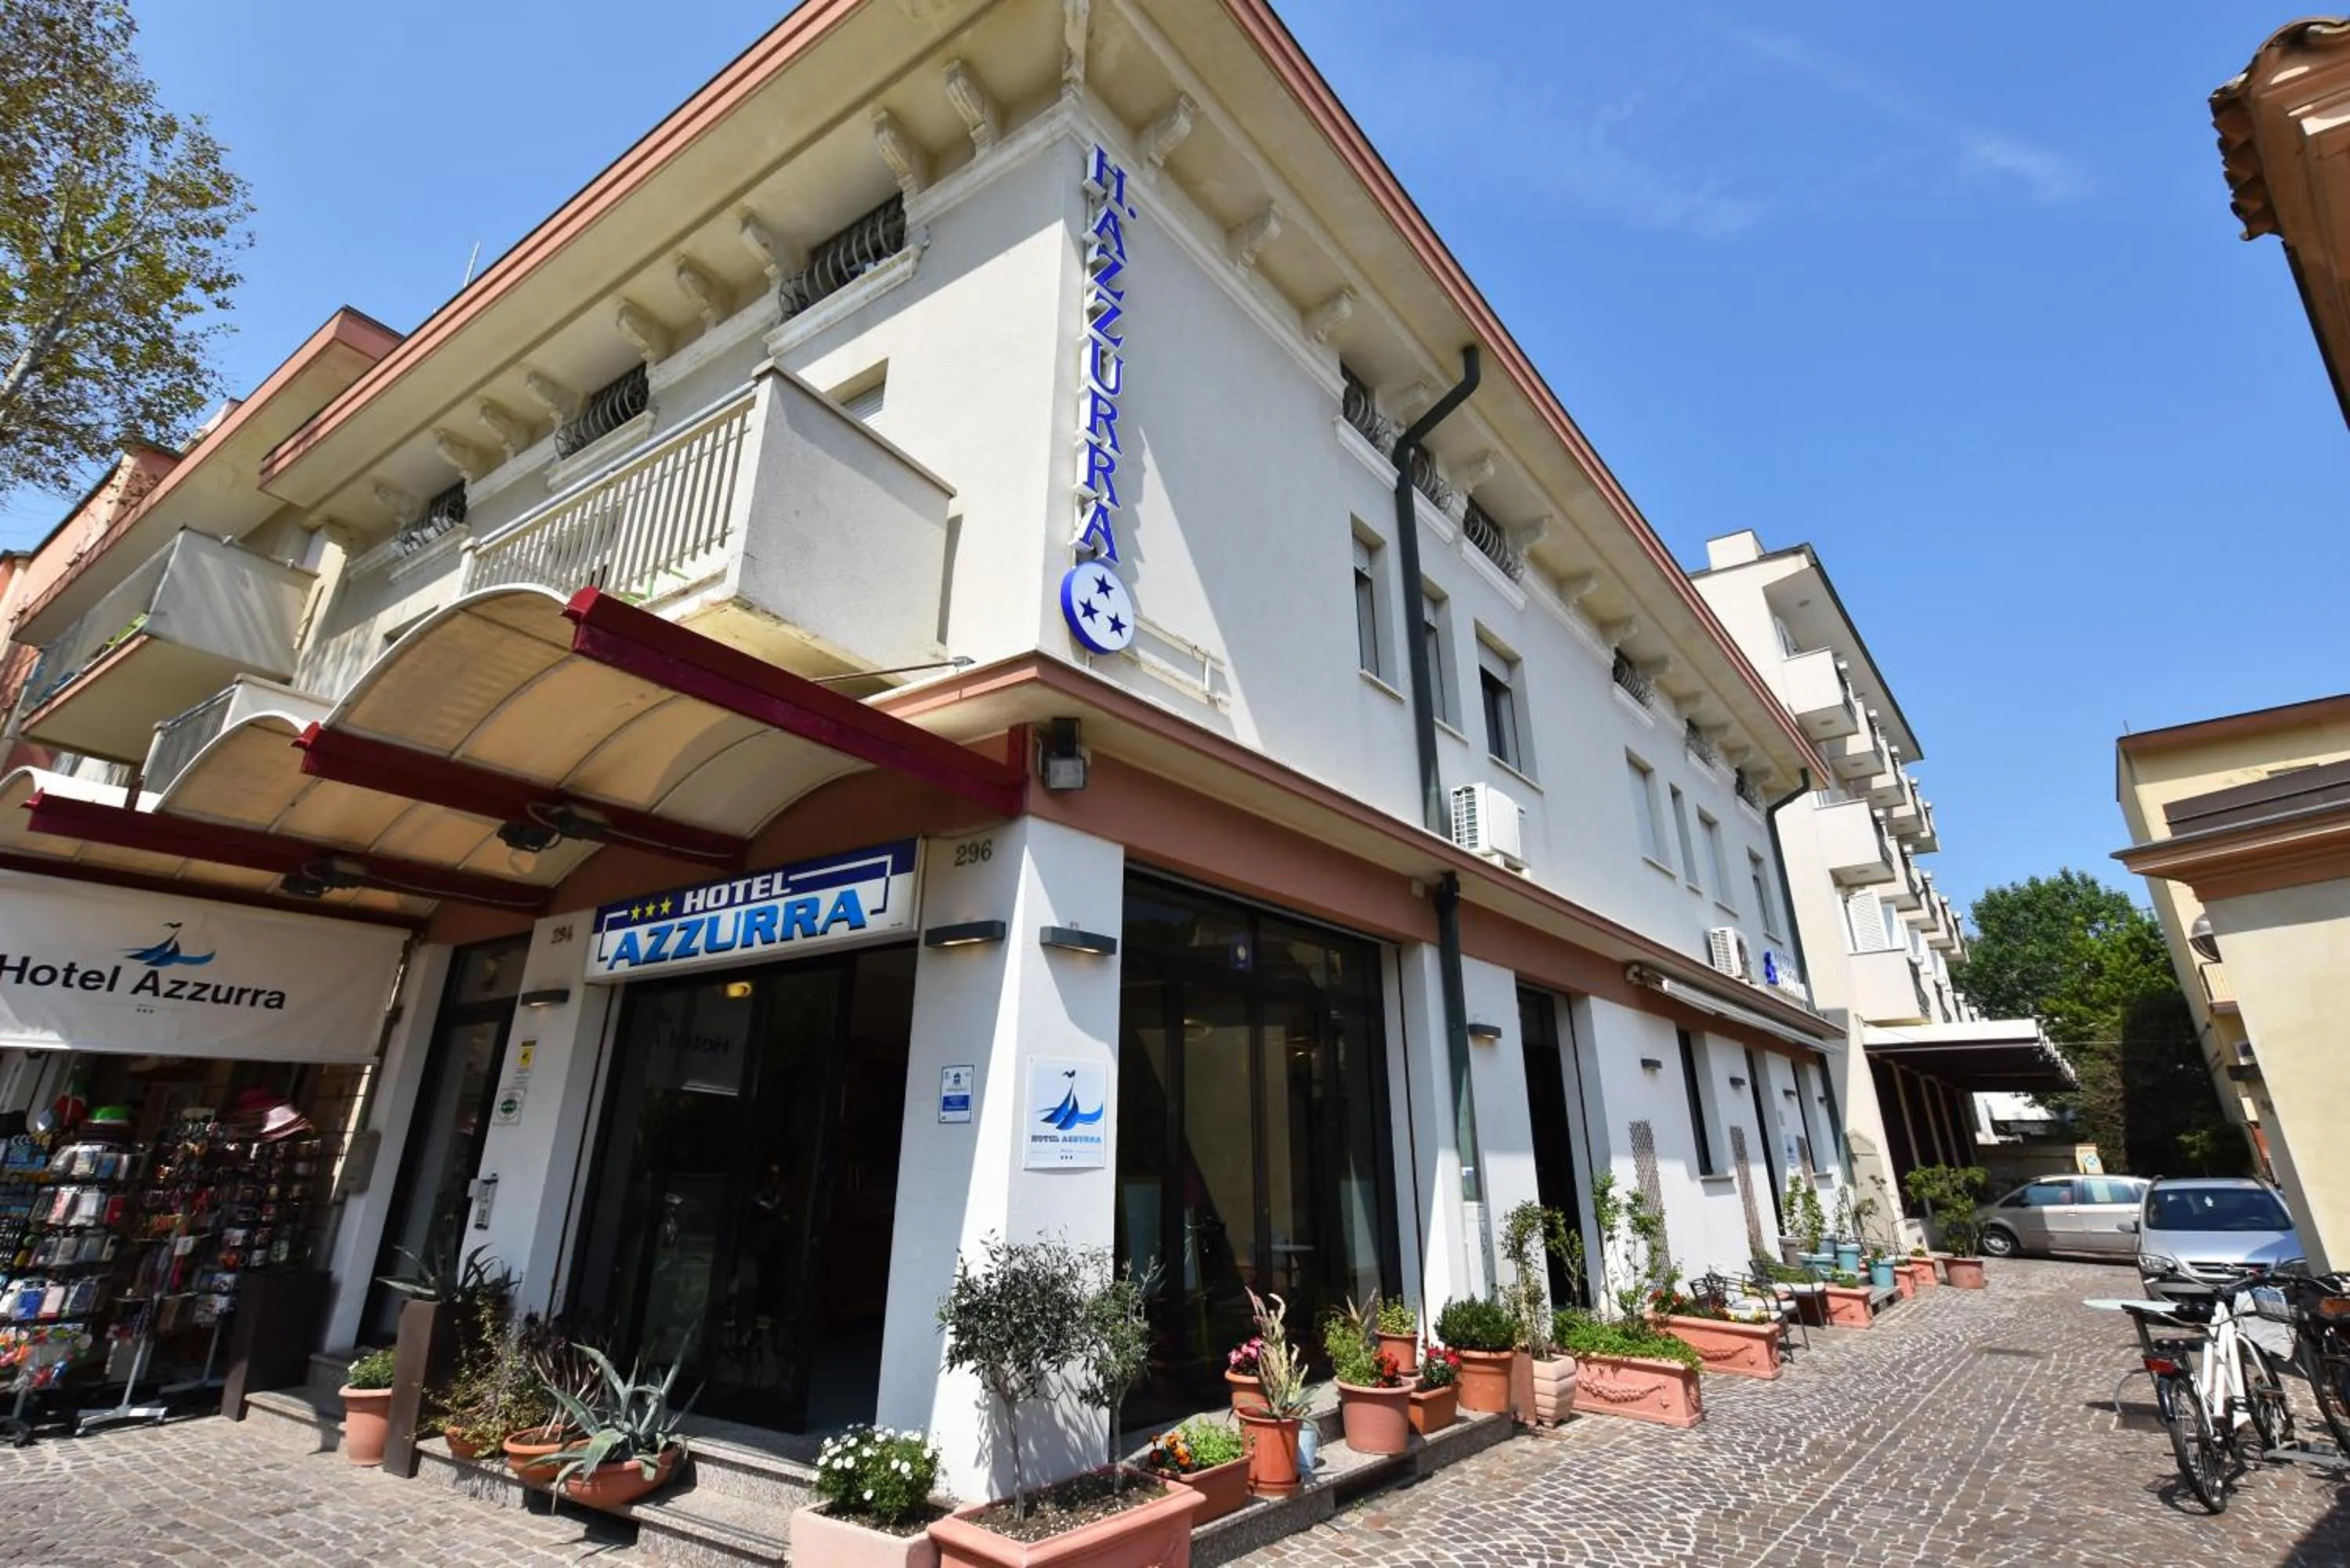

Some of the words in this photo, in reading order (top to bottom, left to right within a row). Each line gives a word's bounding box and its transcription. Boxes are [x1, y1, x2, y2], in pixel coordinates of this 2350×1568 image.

[1079, 208, 1127, 563] AZZURRA
[954, 839, 992, 867] 296
[682, 873, 792, 914] HOTEL
[607, 889, 866, 970] AZZURRA
[0, 954, 121, 992] Hotel
[129, 970, 286, 1010] Azzurra
